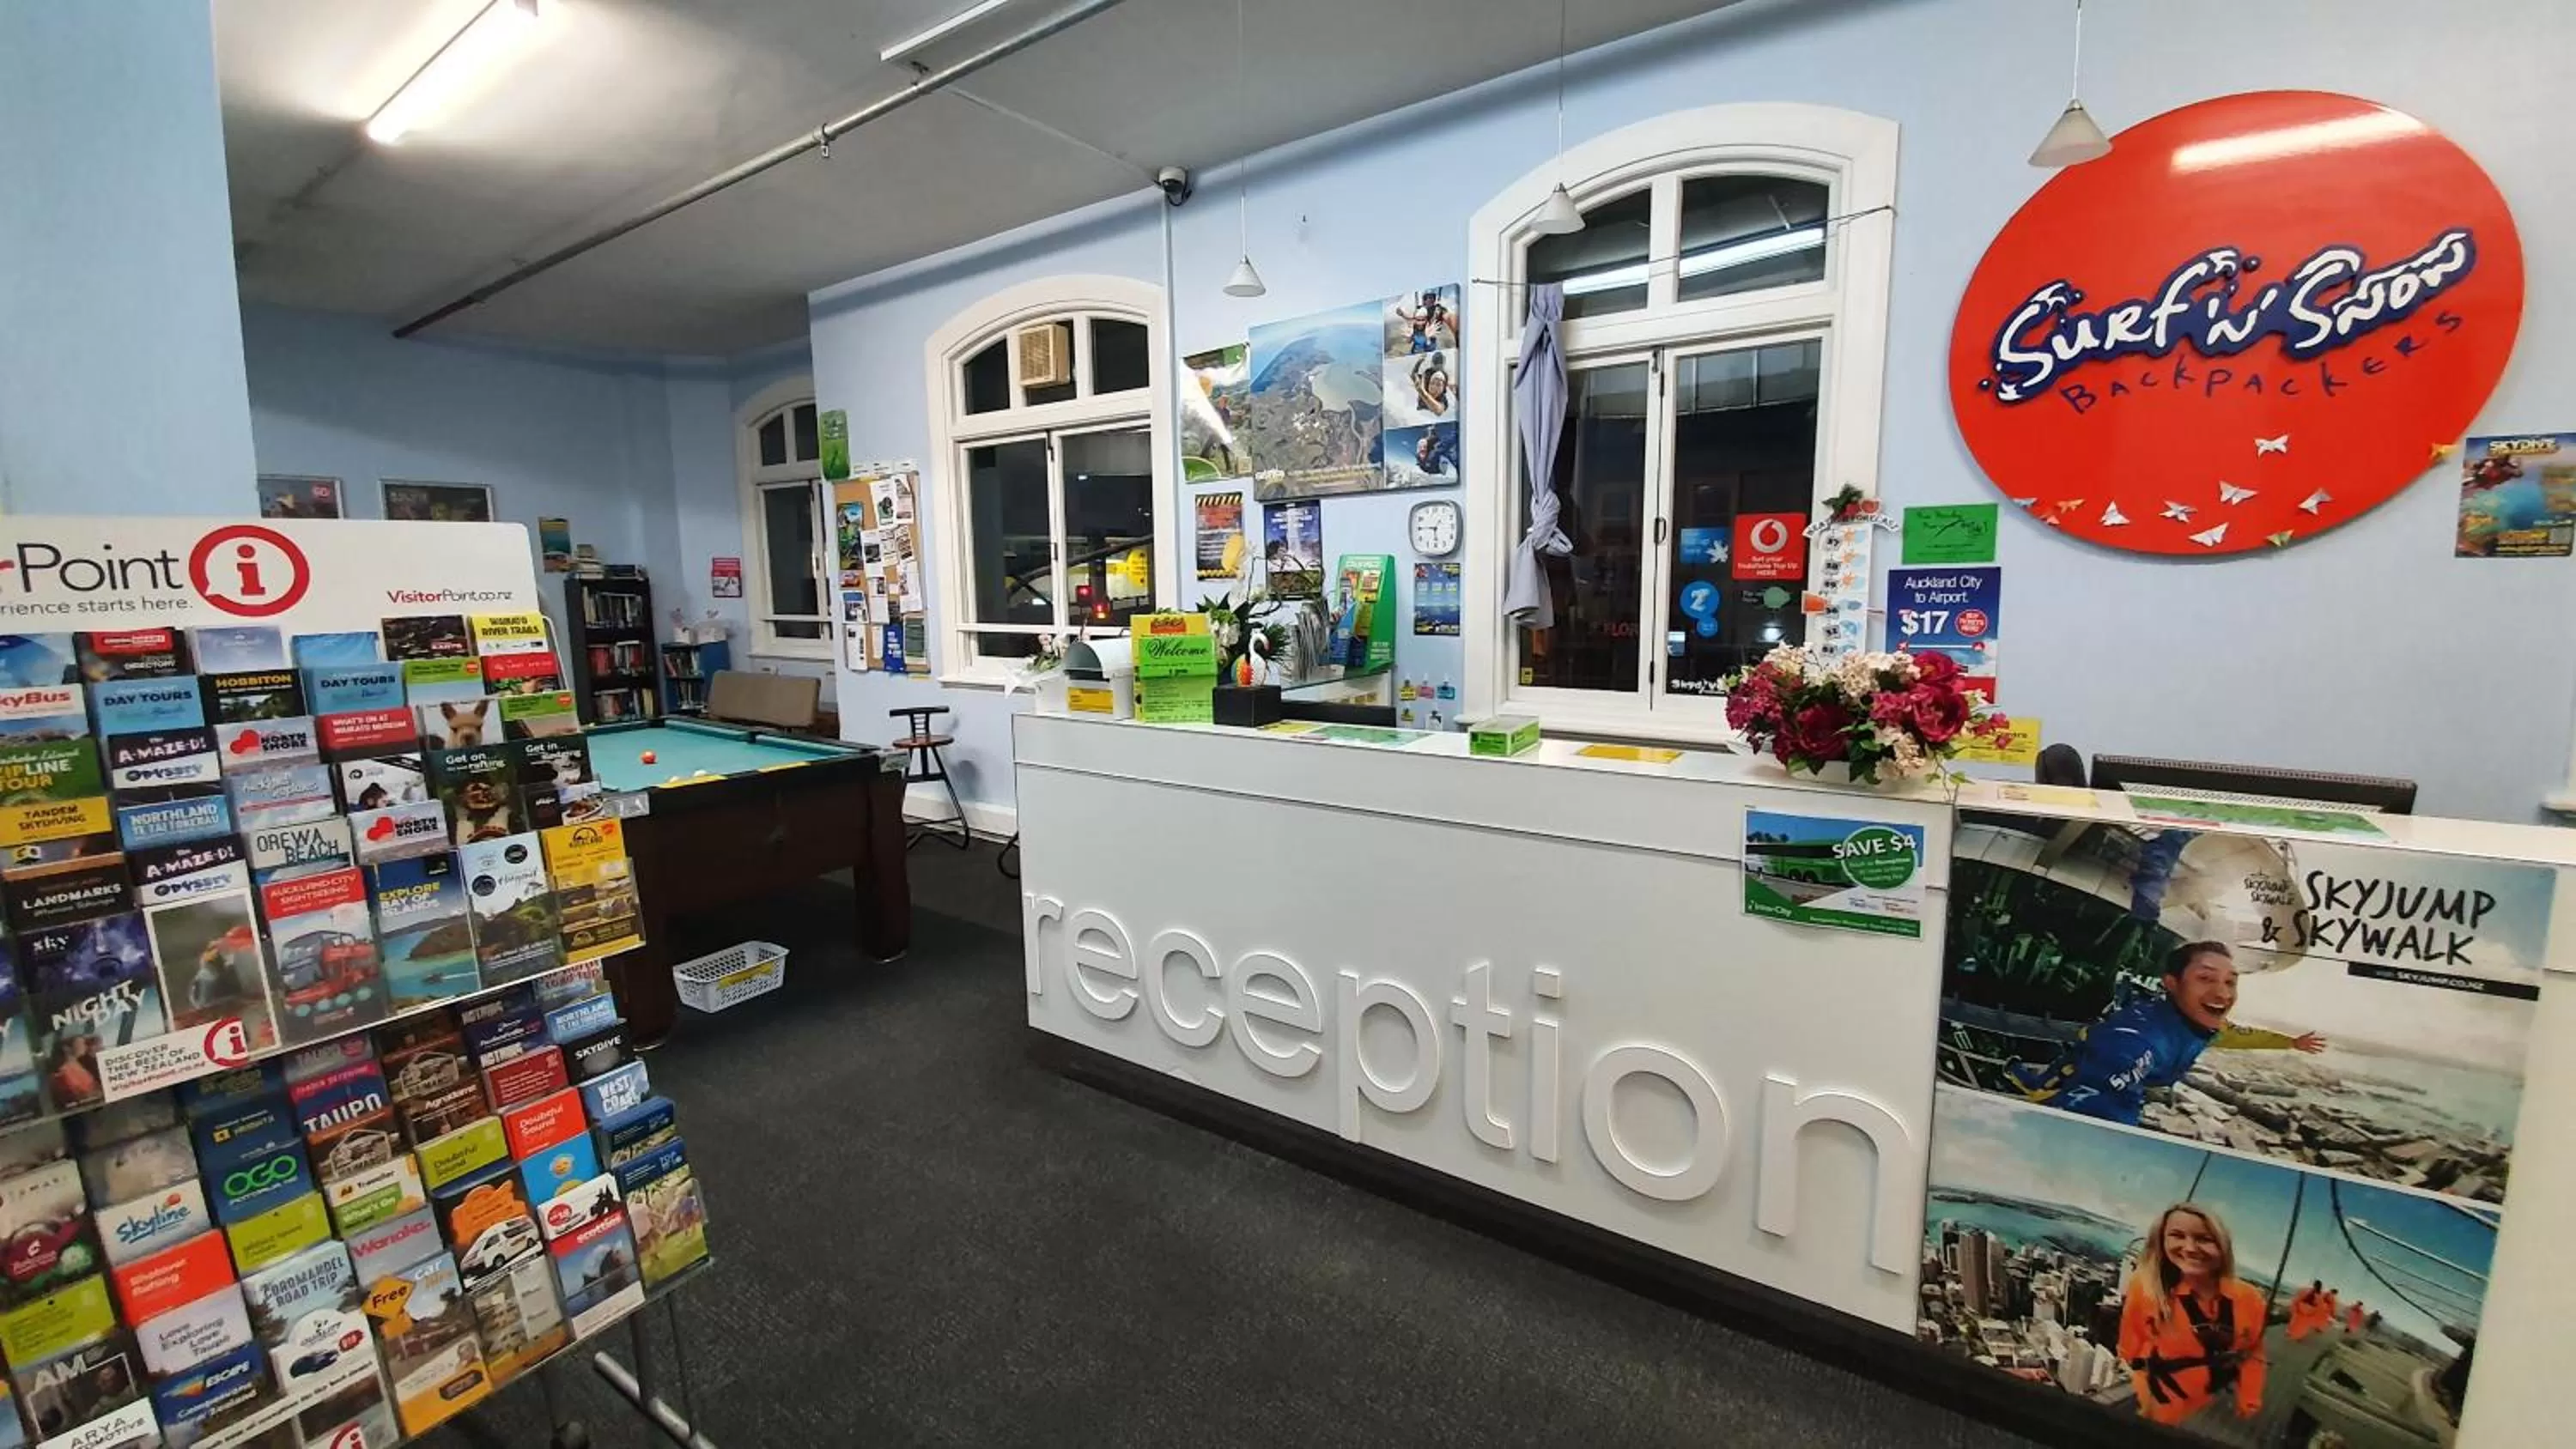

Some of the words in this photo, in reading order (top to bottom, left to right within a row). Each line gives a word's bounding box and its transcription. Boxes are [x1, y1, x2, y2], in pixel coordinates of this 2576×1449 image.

[2062, 311, 2463, 413] BACKPACKERS
[1904, 576, 1957, 590] Auckland
[1959, 575, 1983, 591] City
[78, 597, 137, 614] starts
[142, 596, 194, 611] here.
[1915, 592, 1926, 604] to
[1900, 609, 1950, 636] $17
[1145, 639, 1208, 660] Welcome
[216, 674, 294, 688] HOBBITON
[319, 677, 349, 688] DAY
[352, 675, 397, 687] TOURS
[103, 692, 136, 707] DAY
[140, 689, 193, 703] TOURS
[260, 731, 307, 744] NORTH
[262, 740, 308, 751] SHORE
[526, 743, 545, 754] Get
[446, 755, 467, 766] Get
[24, 803, 79, 819] TANDEM
[130, 803, 218, 826] NORTHLAND
[394, 816, 438, 831] NORTH
[396, 825, 439, 837] SHORE
[258, 827, 325, 853] OREWA
[1832, 839, 1886, 859] SAVE
[1890, 833, 1917, 852] $4
[285, 840, 339, 864] BEACH
[22, 882, 124, 910] LANDMARKS
[270, 880, 331, 899] AUCKLAND
[379, 881, 440, 901] EXPLORE
[2305, 870, 2497, 930] SKYJUMP
[2260, 916, 2282, 943] &
[2293, 908, 2474, 966] SKYWALK
[104, 1044, 169, 1066] DISCOVER
[574, 1035, 622, 1060] SKYDIVE
[106, 1061, 131, 1075] THE
[135, 1053, 166, 1067] BEST
[168, 1047, 186, 1059] OF
[107, 1069, 139, 1082] NEW
[142, 1052, 201, 1074] ZEALAND
[1023, 890, 1912, 1276] reception
[519, 1105, 564, 1130] Doubtful
[434, 1146, 477, 1169] Doubtful
[224, 1155, 298, 1198] OGO
[276, 1287, 310, 1308] ROAD
[313, 1271, 338, 1291] TRIP
[372, 1285, 408, 1310] Free
[71, 1417, 127, 1448] ARYA
